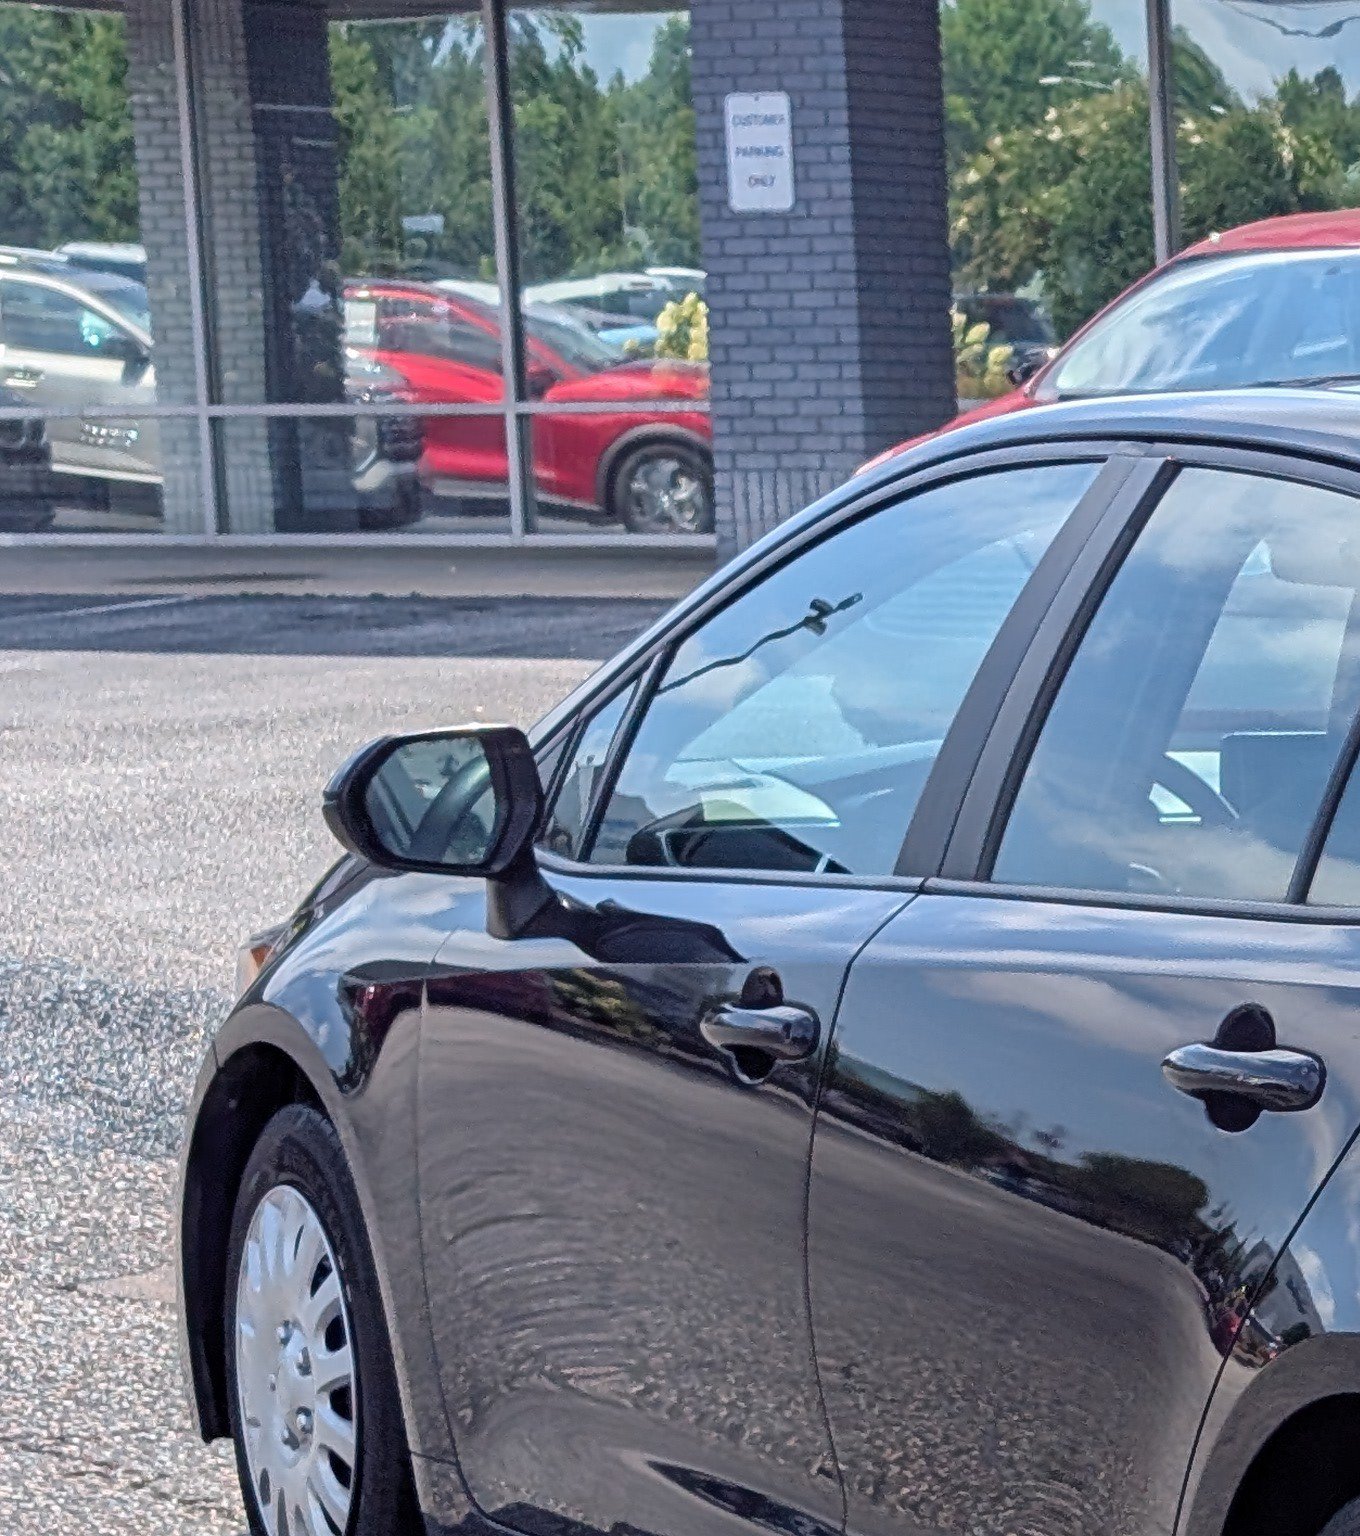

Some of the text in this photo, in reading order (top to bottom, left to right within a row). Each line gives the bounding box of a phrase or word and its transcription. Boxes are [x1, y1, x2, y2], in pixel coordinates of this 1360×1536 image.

[732, 113, 785, 127] CUSTOMER
[735, 145, 784, 158] PARKING
[748, 174, 776, 188] ONLY
